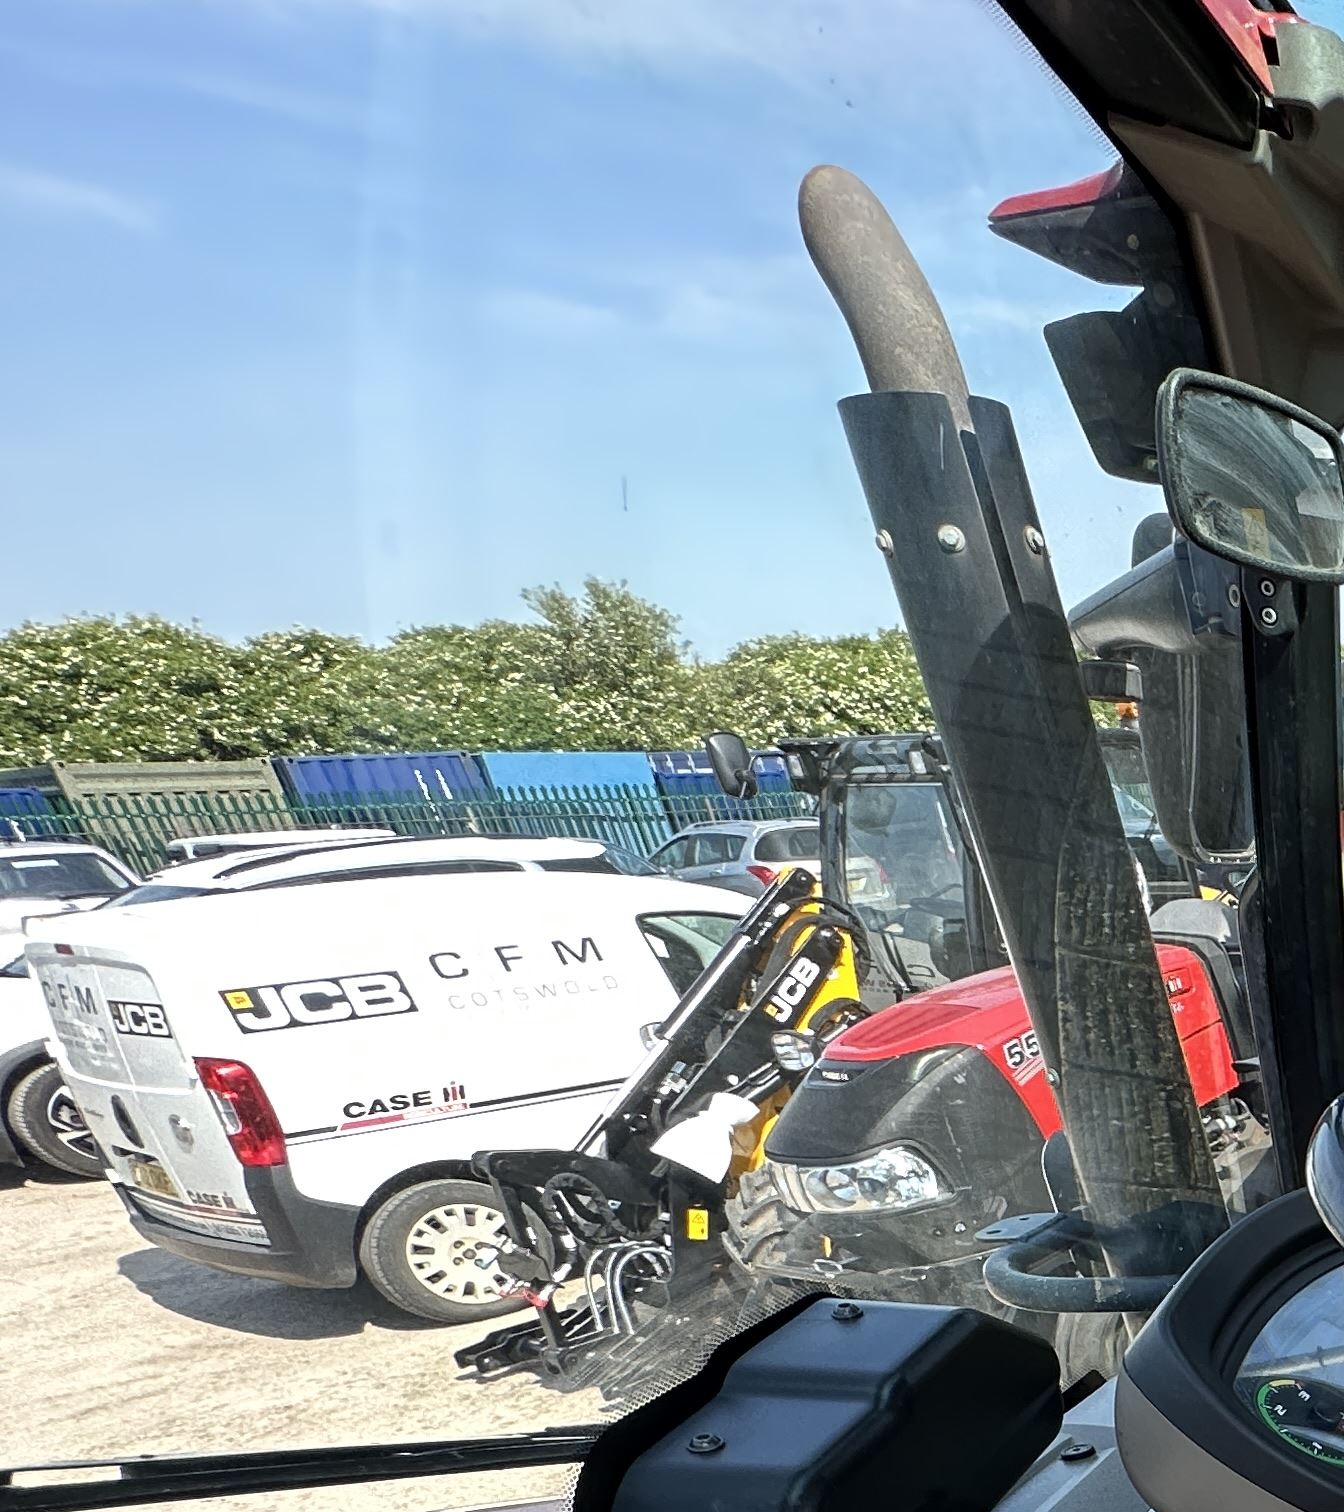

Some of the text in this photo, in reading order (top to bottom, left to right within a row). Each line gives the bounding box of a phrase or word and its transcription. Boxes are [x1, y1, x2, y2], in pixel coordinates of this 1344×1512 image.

[230, 973, 414, 1031] JCB
[774, 956, 820, 1024] JCB
[112, 1001, 171, 1037] JCB
[343, 1090, 433, 1118] CASE
